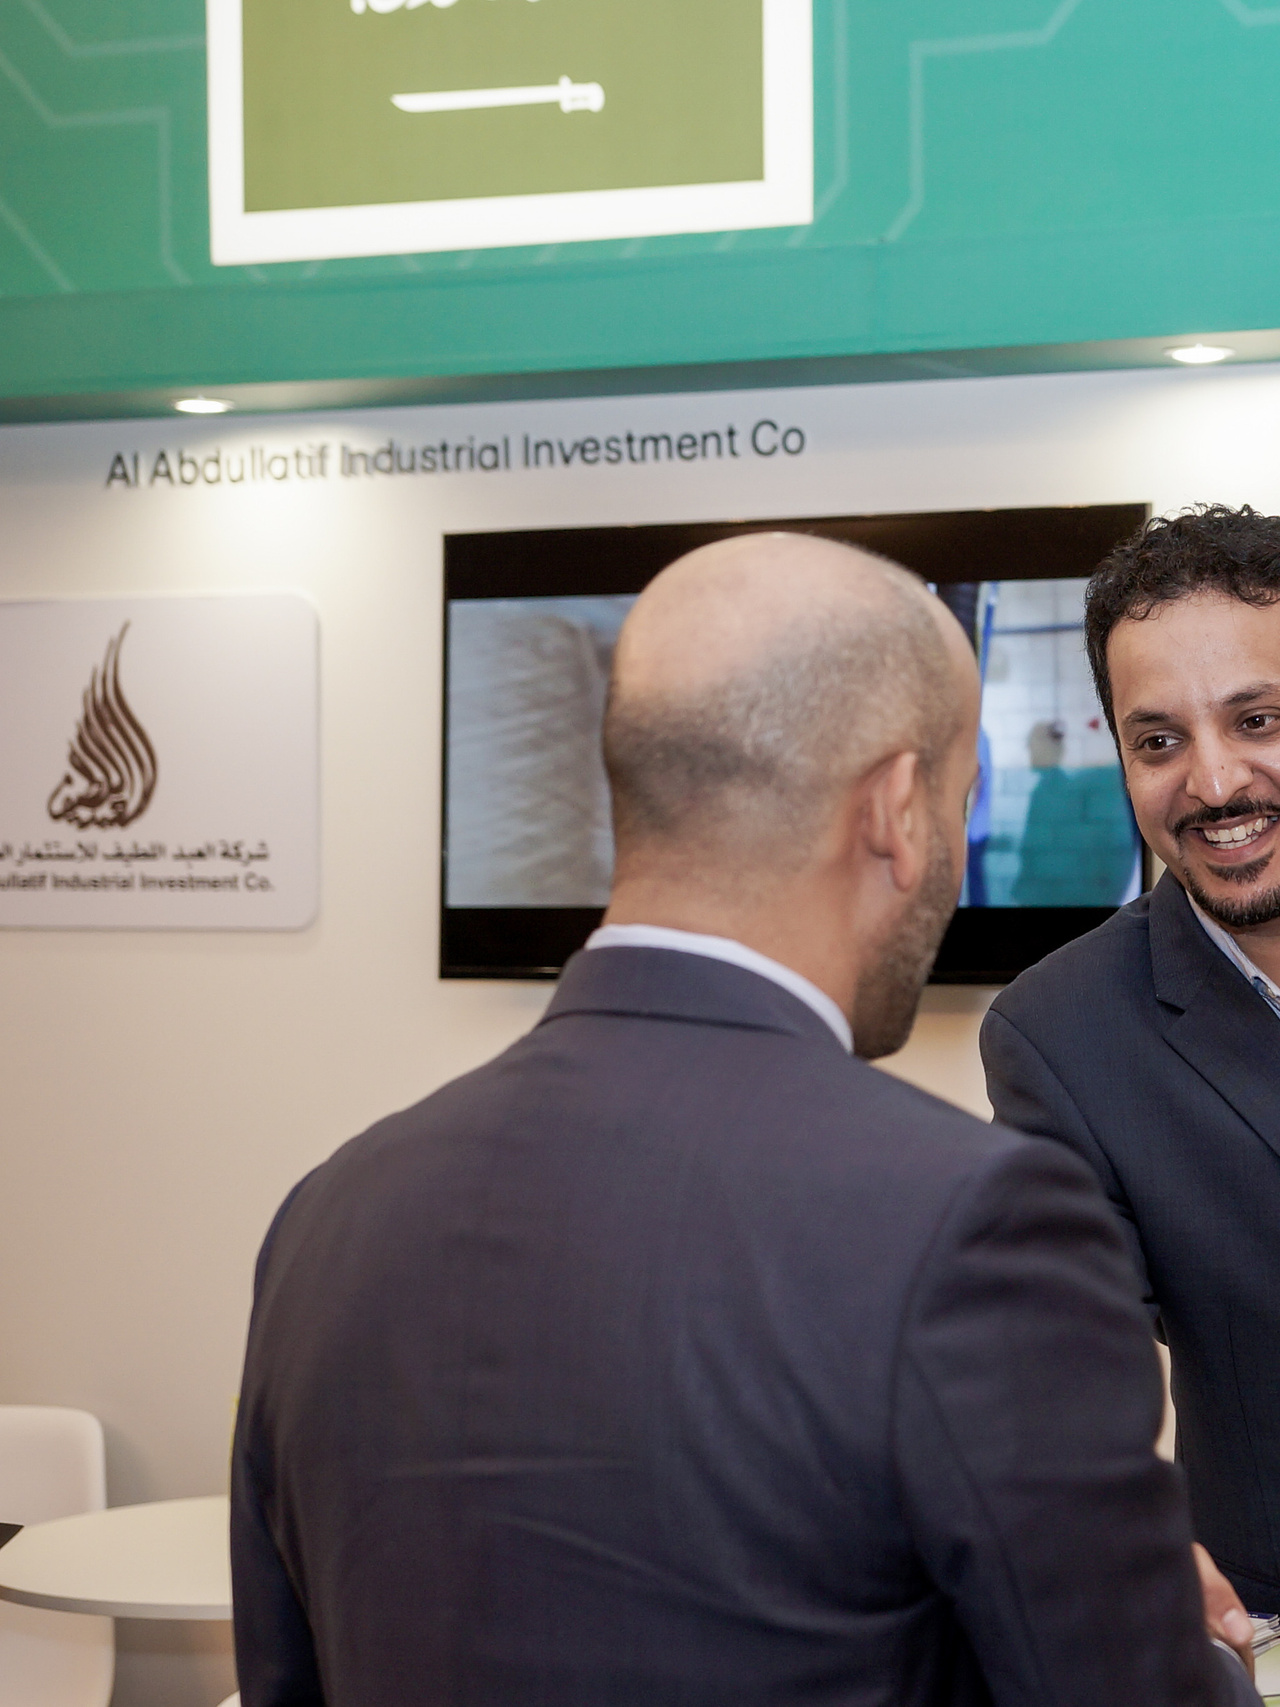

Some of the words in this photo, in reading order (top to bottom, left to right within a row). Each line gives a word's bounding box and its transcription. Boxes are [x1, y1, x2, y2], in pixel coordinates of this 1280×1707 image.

[106, 451, 140, 488] Al
[150, 444, 333, 484] Abdullatif
[339, 436, 511, 477] Industrial
[523, 424, 739, 469] Investment
[751, 419, 806, 457] Co
[102, 841, 166, 868] اللطيف
[171, 844, 215, 869] العبد
[220, 839, 270, 867] شركة
[52, 873, 135, 890] Industrial
[139, 873, 239, 890] Investment
